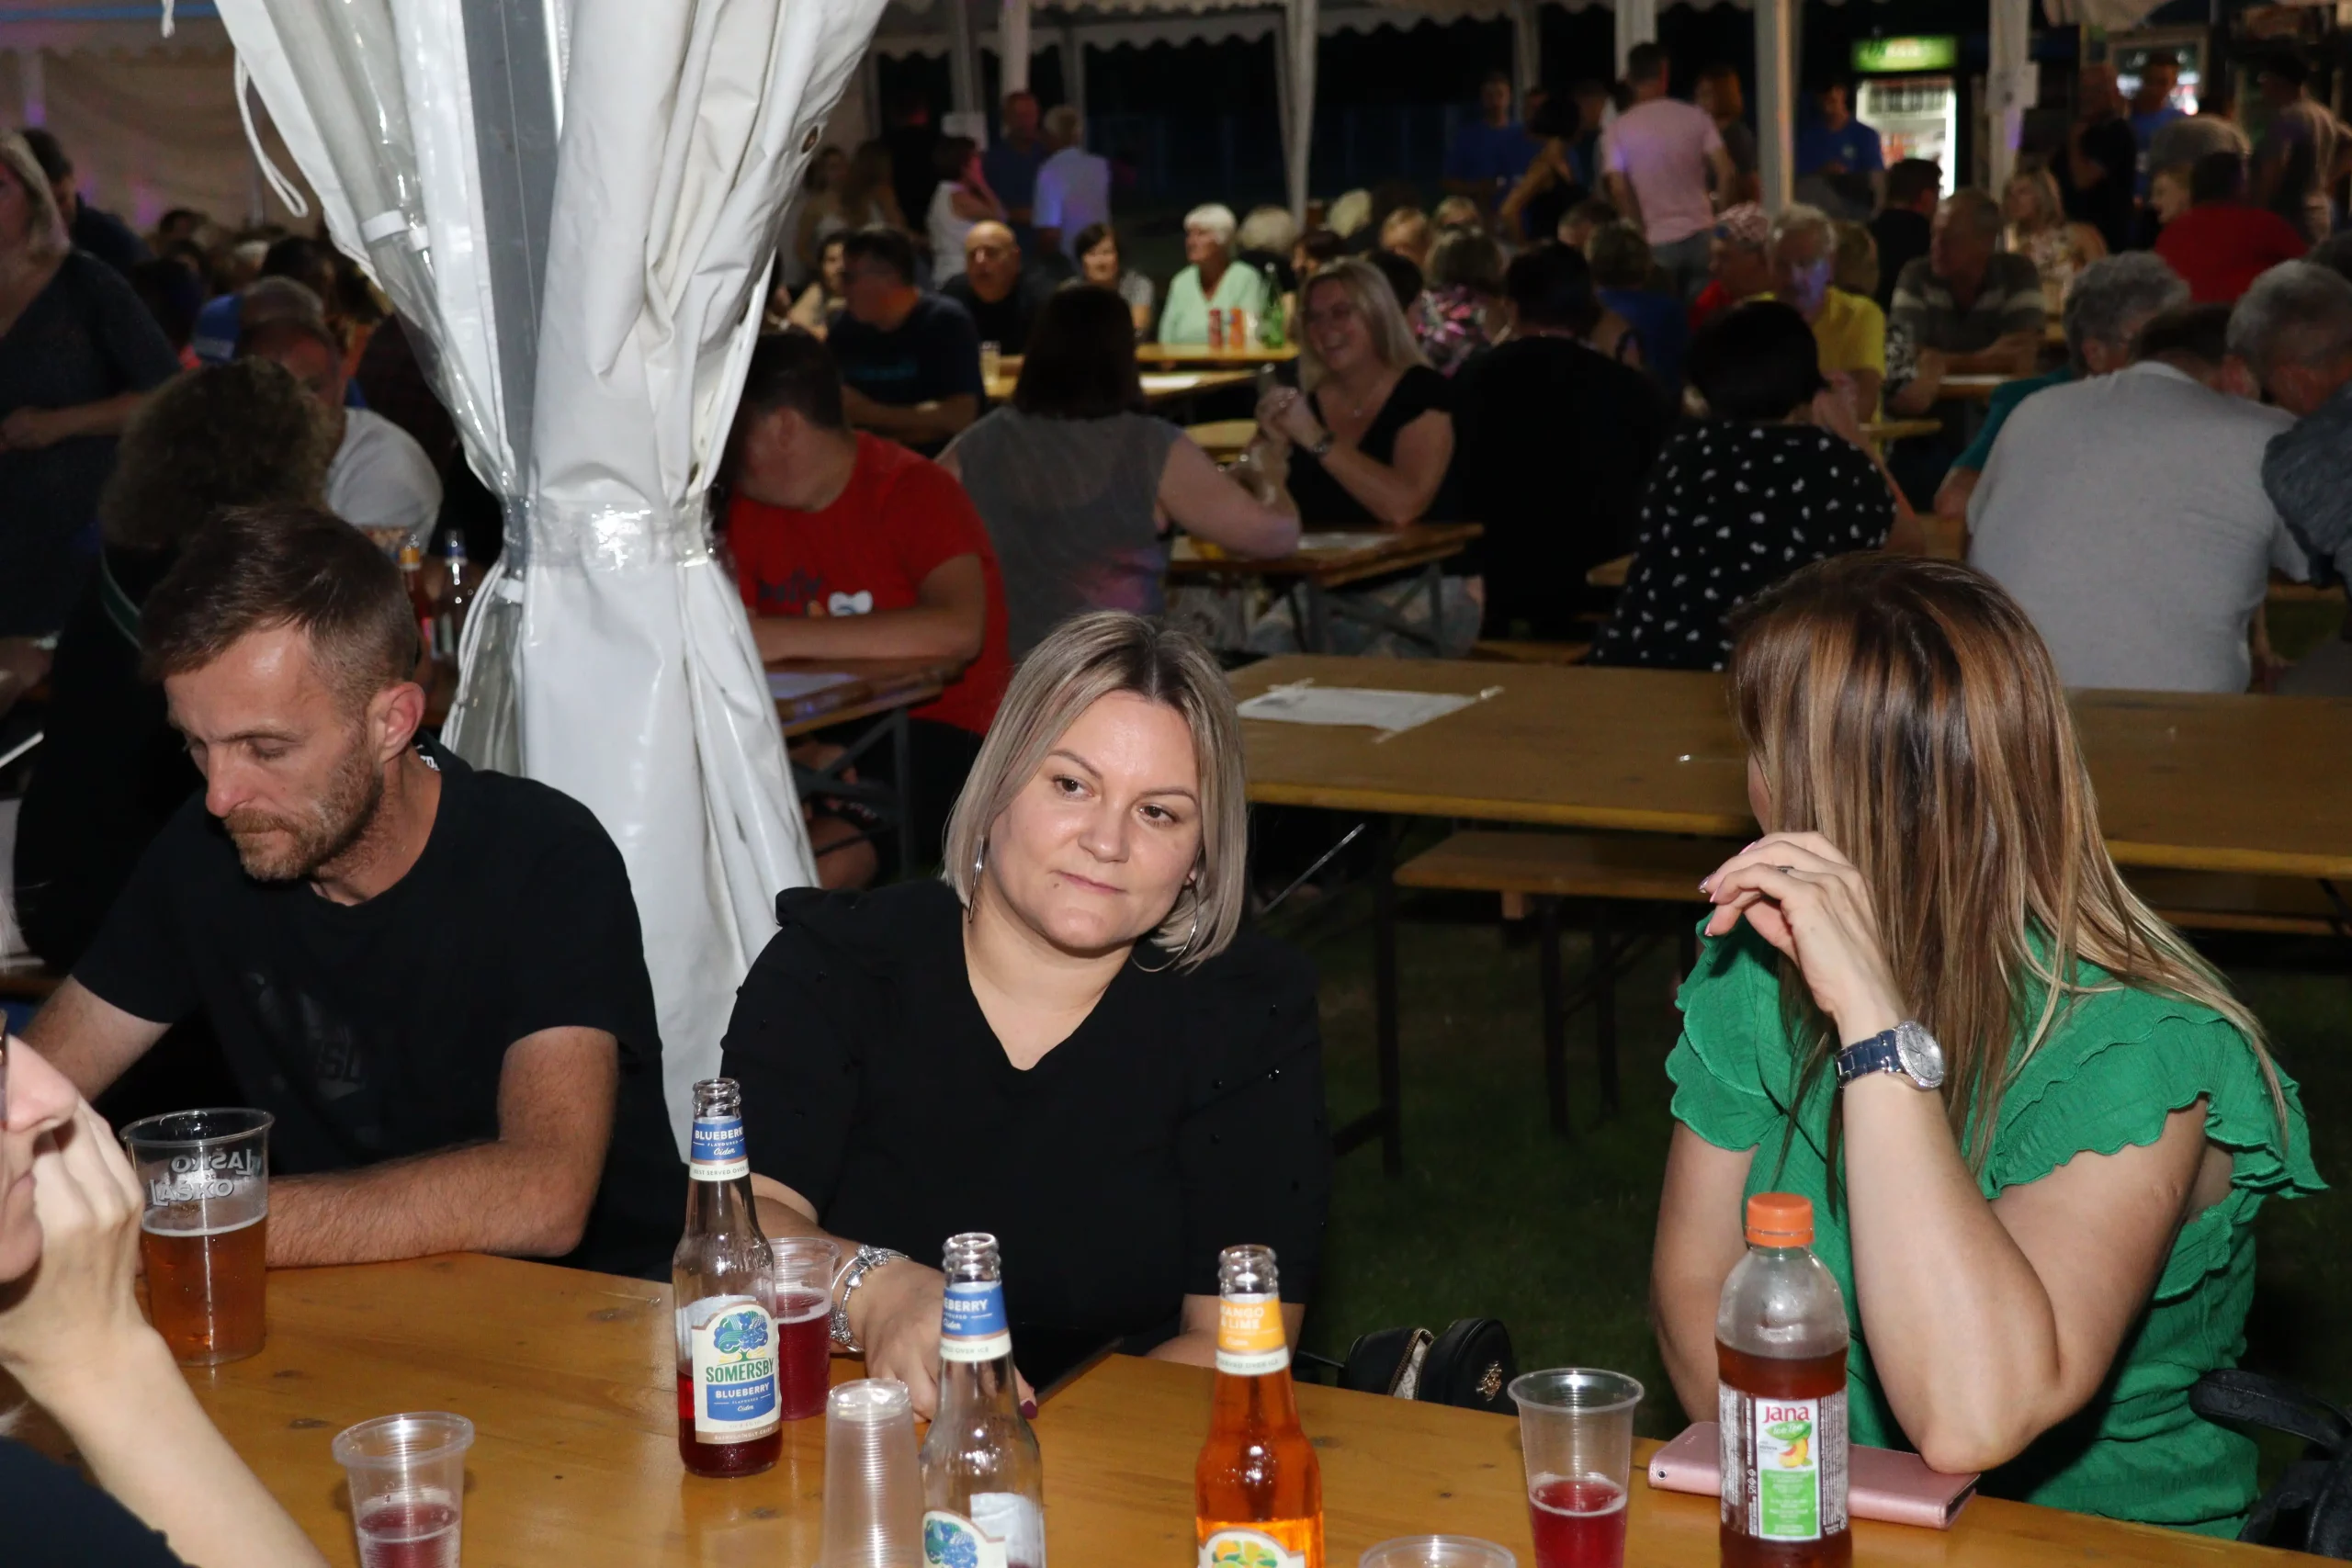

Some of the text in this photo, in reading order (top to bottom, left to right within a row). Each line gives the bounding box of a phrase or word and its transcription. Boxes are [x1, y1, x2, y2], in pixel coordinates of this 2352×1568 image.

[695, 1125, 743, 1141] BLUEBERR
[713, 1147, 736, 1156] Cider
[1228, 1318, 1261, 1329] LIME
[706, 1358, 775, 1383] SOMERSBY
[715, 1382, 770, 1399] BLUEBERRY
